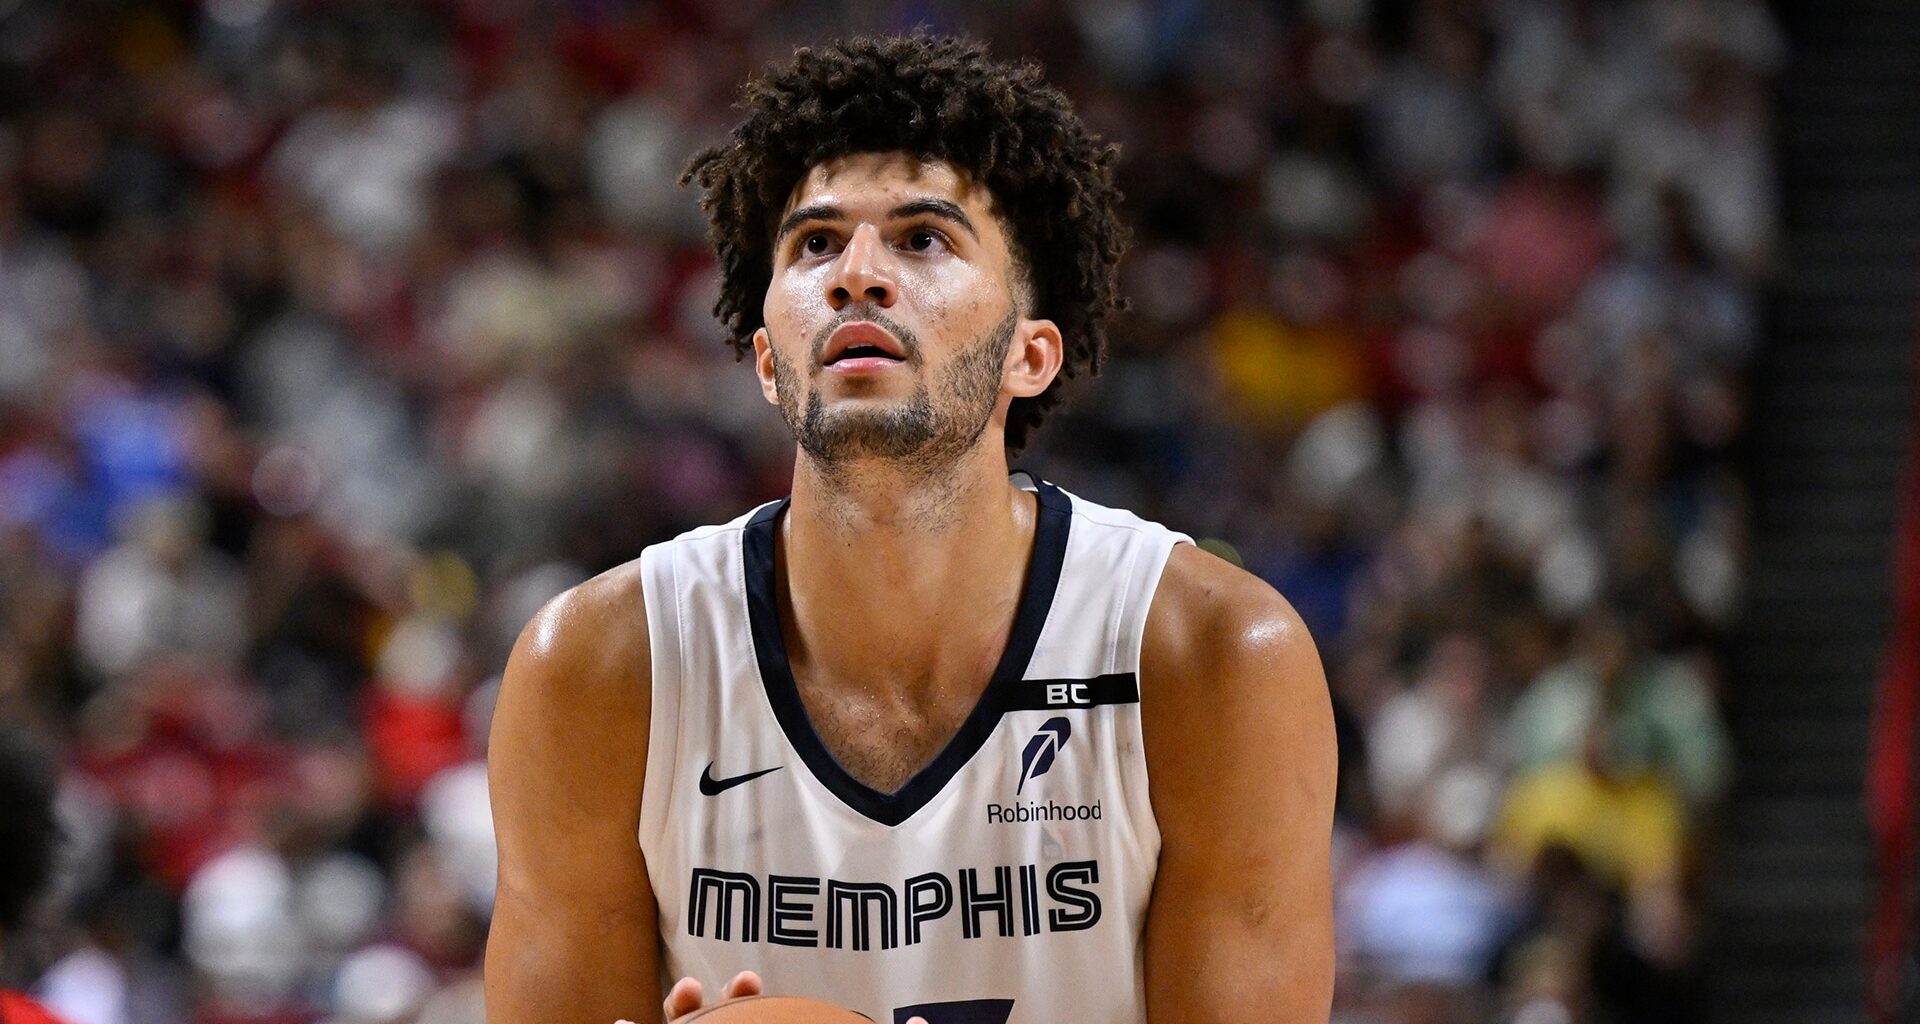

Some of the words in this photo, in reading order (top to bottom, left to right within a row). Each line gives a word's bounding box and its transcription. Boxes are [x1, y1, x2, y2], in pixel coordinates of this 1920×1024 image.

[1046, 683, 1091, 704] BC
[987, 799, 1102, 824] Robinhood
[688, 860, 1102, 951] MEMPHIS
